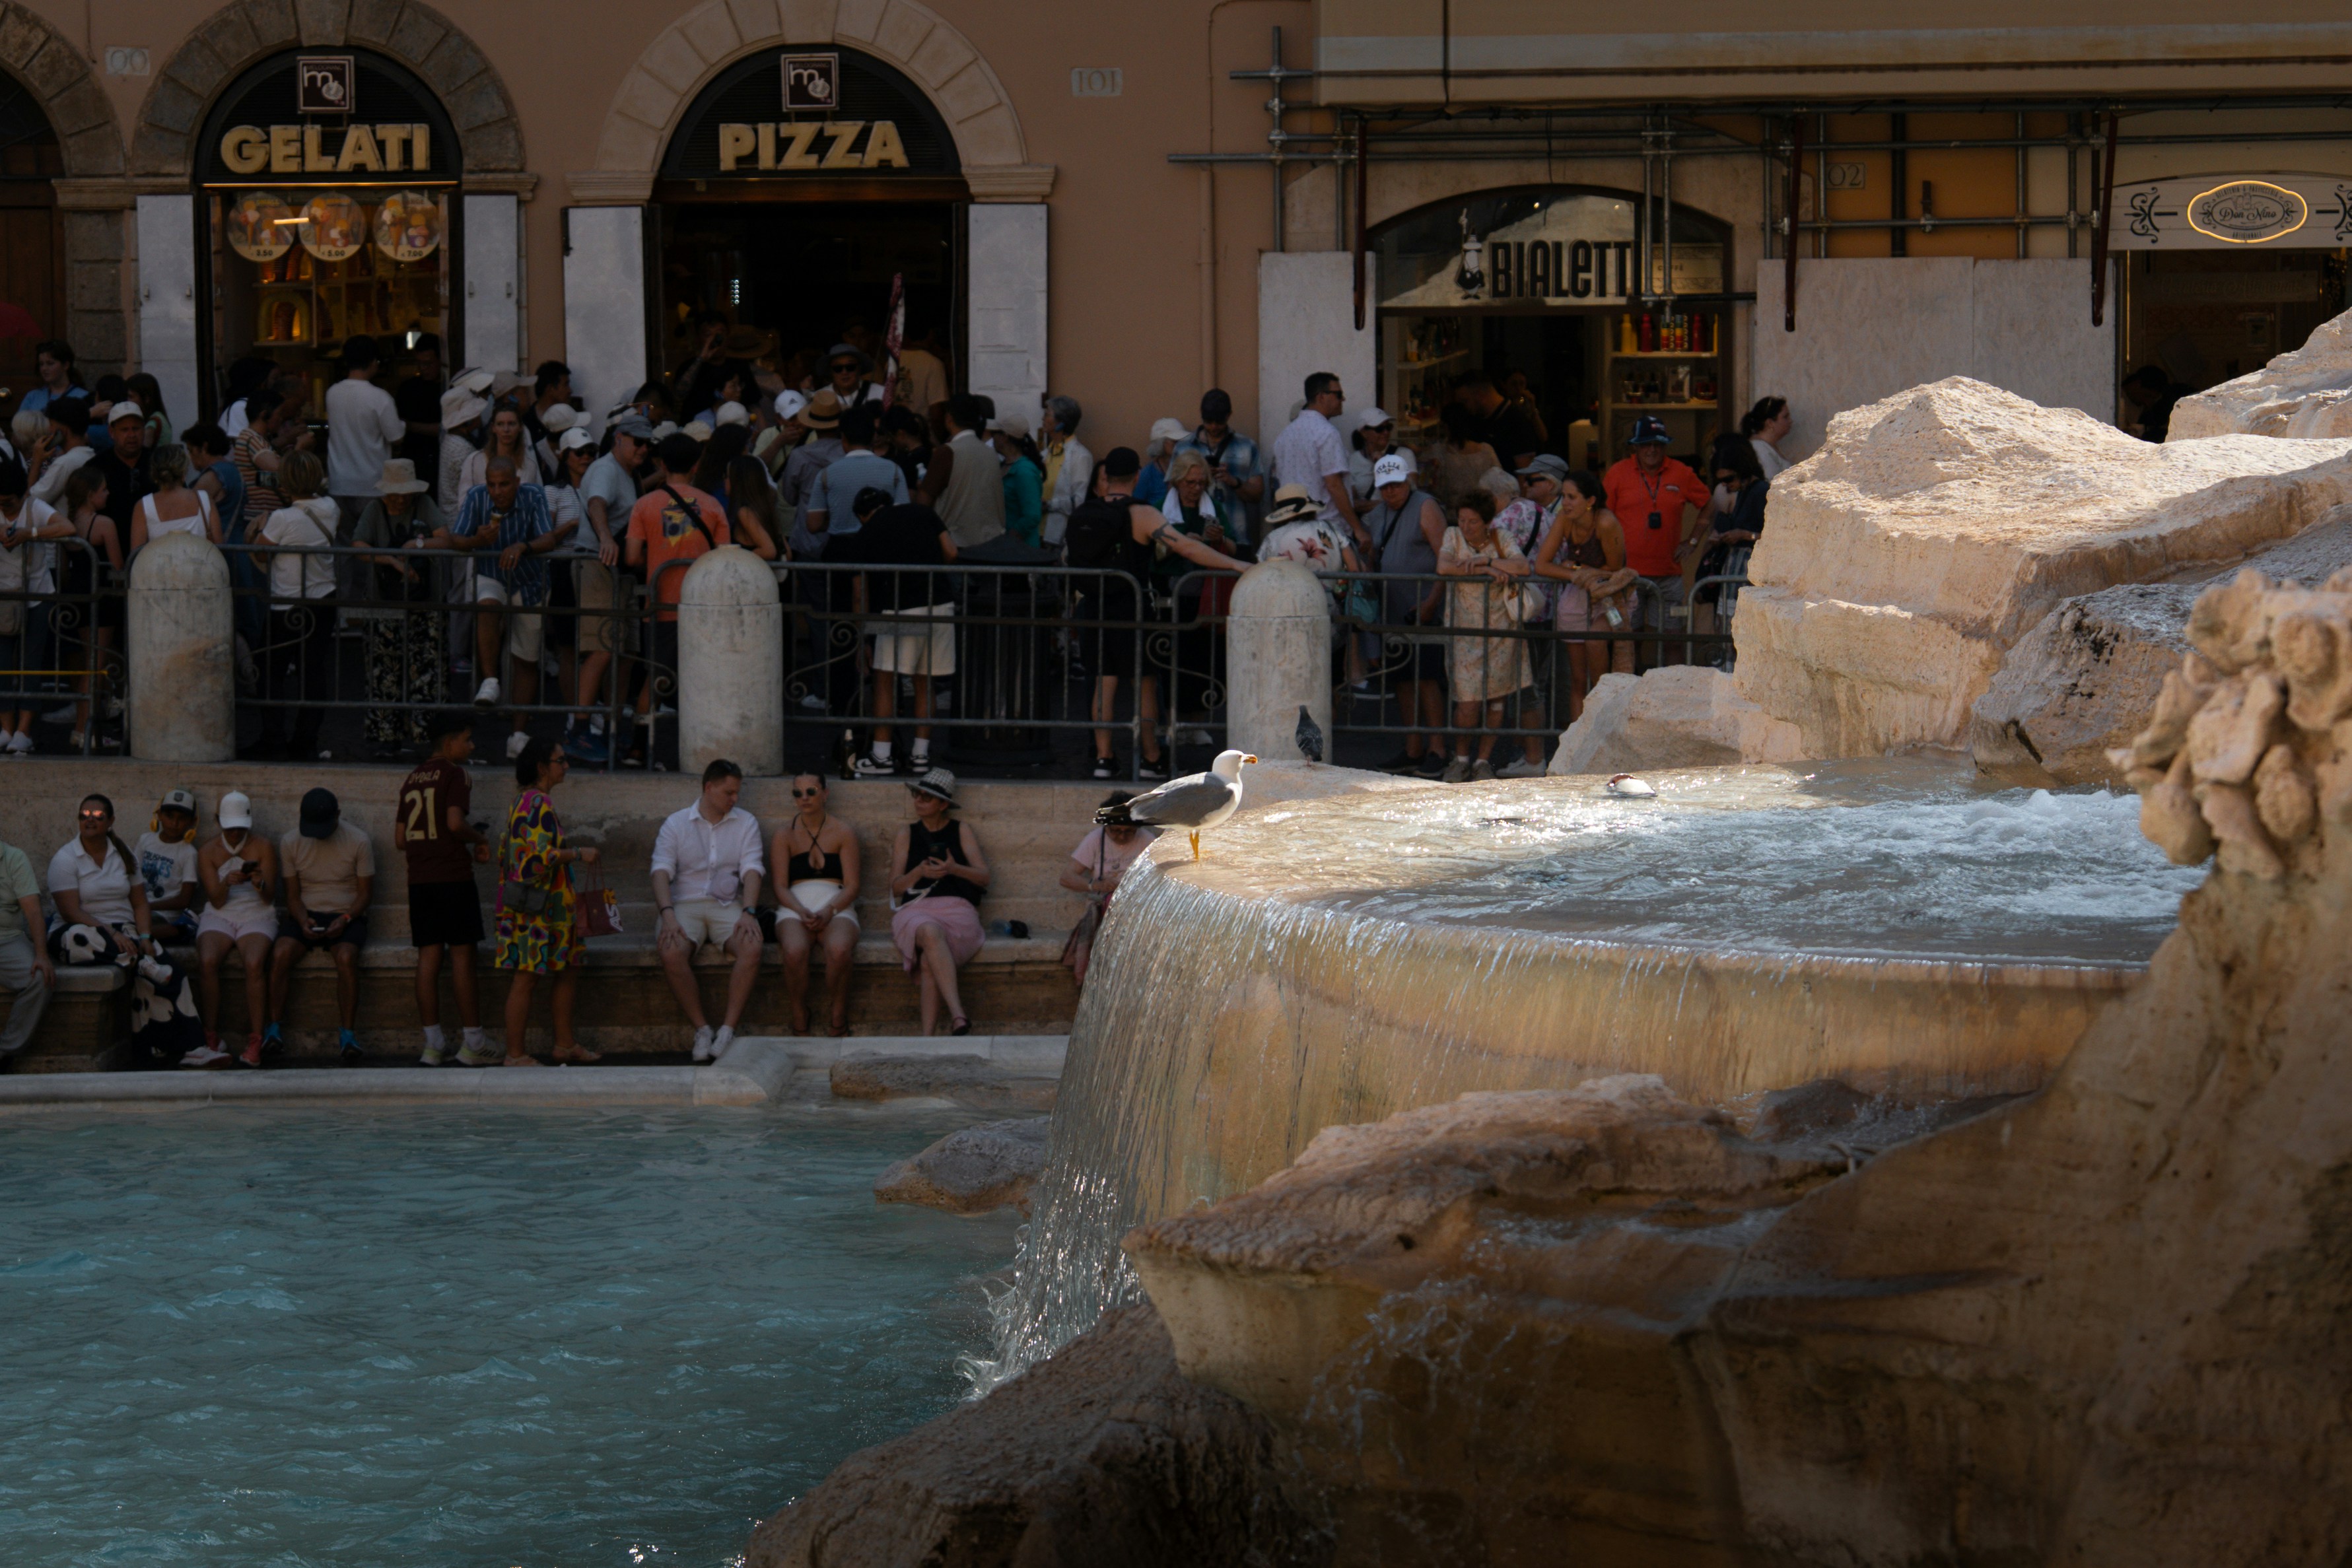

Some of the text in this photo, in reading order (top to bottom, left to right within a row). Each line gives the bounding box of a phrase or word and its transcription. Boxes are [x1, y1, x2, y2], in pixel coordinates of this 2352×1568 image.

[220, 123, 431, 174] GELATI
[719, 120, 910, 170] PIZZA
[1827, 164, 1861, 186] 02
[2219, 206, 2277, 221] Don Nino
[1376, 461, 1400, 474] ITALIA
[405, 787, 438, 842] 21
